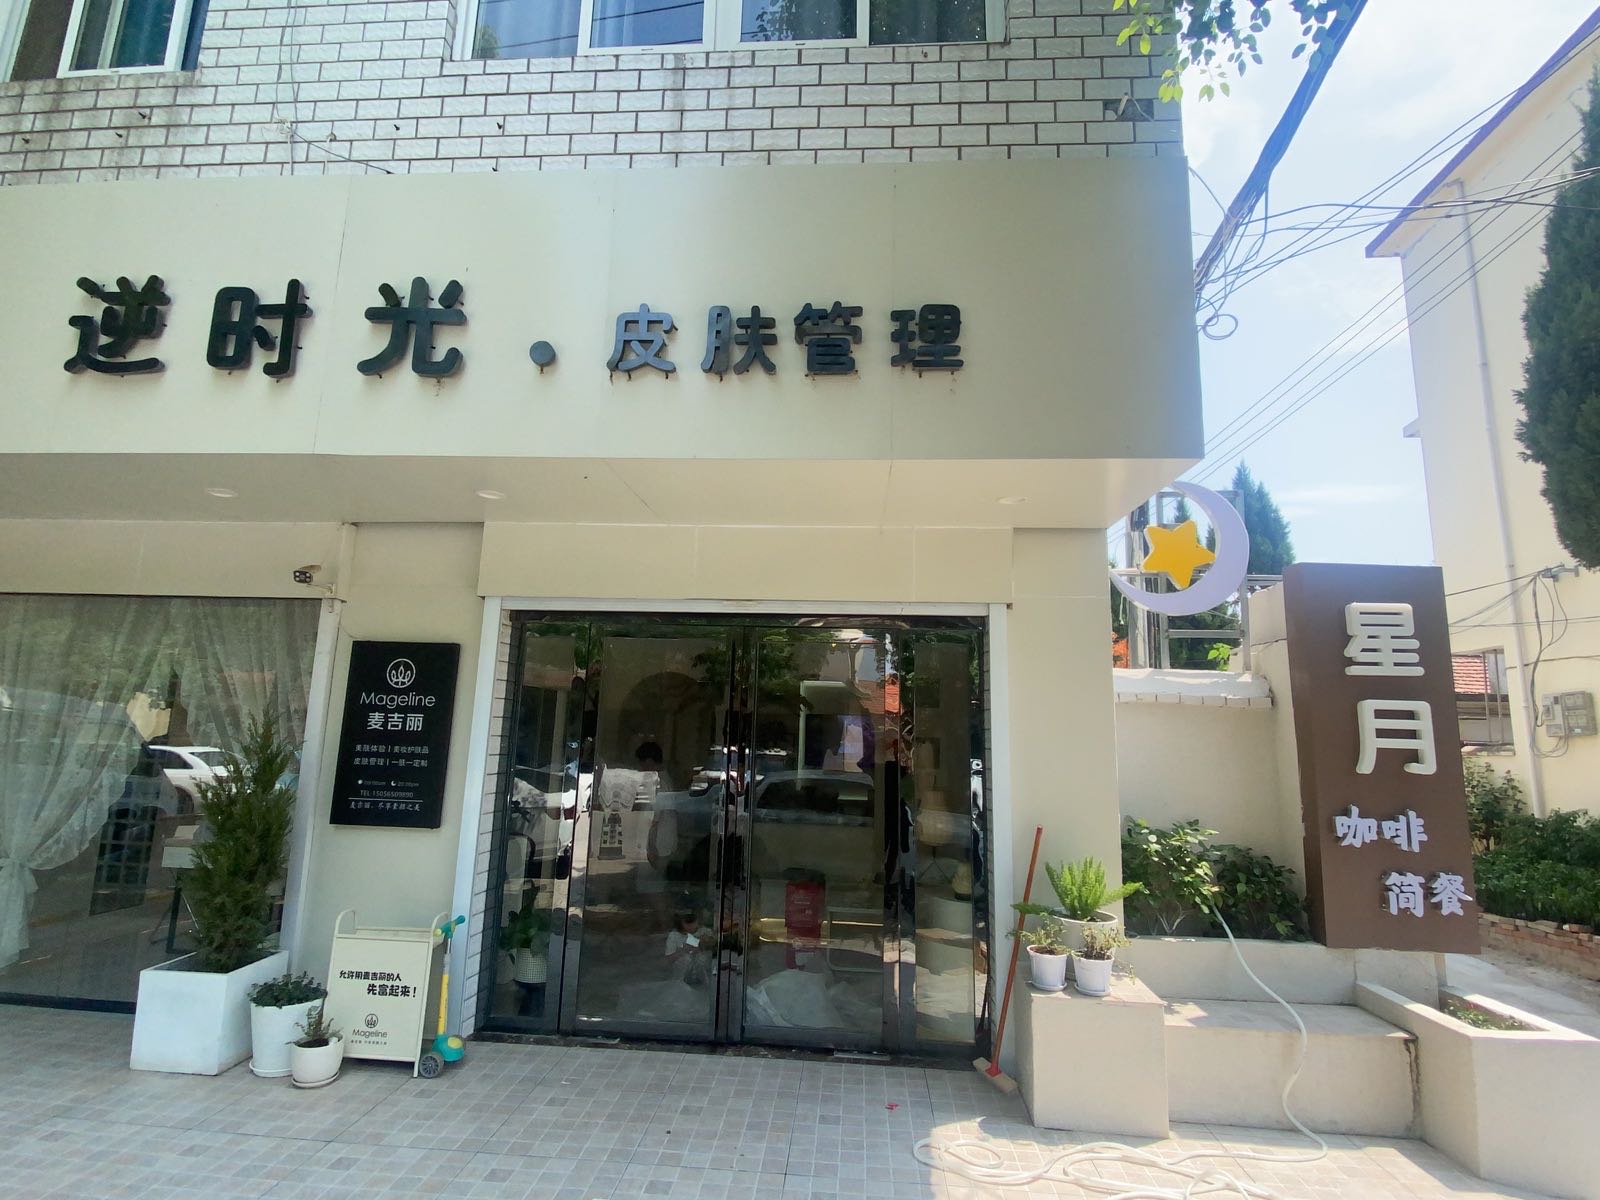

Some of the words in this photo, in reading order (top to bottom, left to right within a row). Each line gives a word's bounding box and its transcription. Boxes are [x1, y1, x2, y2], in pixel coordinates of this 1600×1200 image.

[360, 692, 436, 708] Mageline
[1343, 601, 1438, 776] 星月
[367, 712, 424, 731] 麦吉丽
[1334, 805, 1428, 853] 咖啡
[1384, 871, 1473, 918] 简餐
[352, 1029, 388, 1039] Mageline
